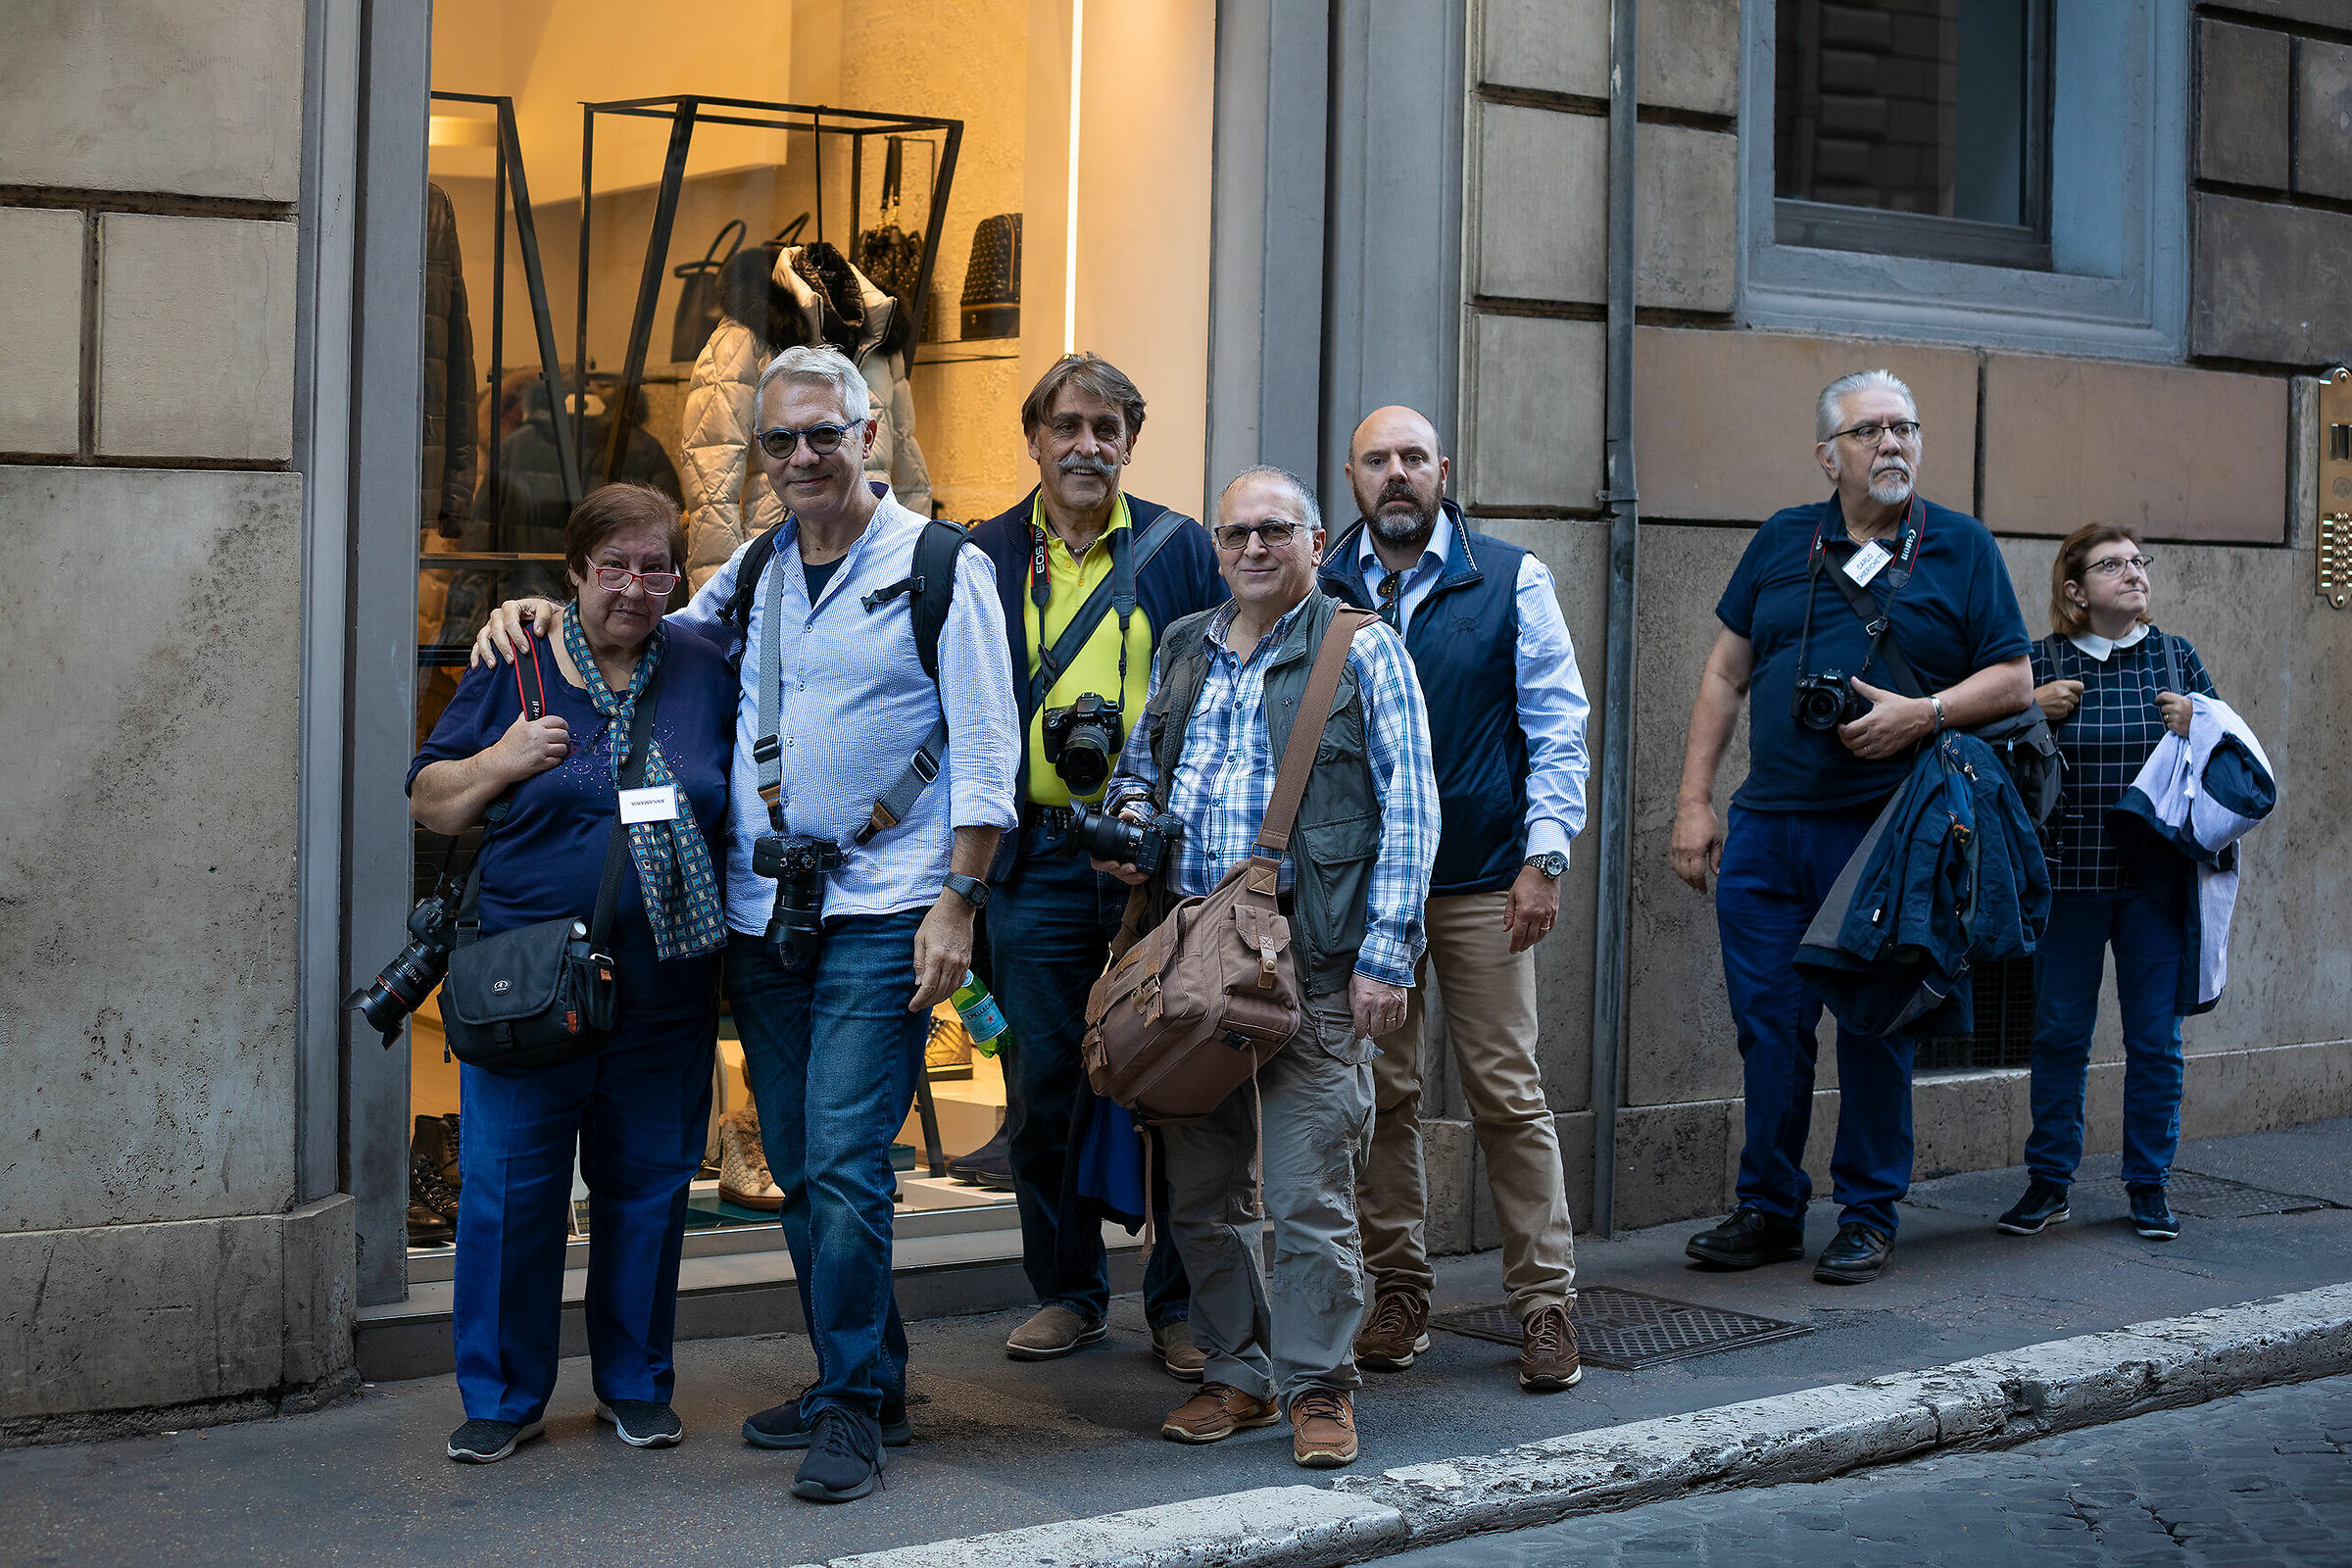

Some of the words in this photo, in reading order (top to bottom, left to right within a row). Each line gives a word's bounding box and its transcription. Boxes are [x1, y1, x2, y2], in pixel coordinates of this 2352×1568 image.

[1900, 528, 1917, 561] Canon
[1035, 545, 1046, 574] EOS
[1856, 553, 1874, 569] CARLO
